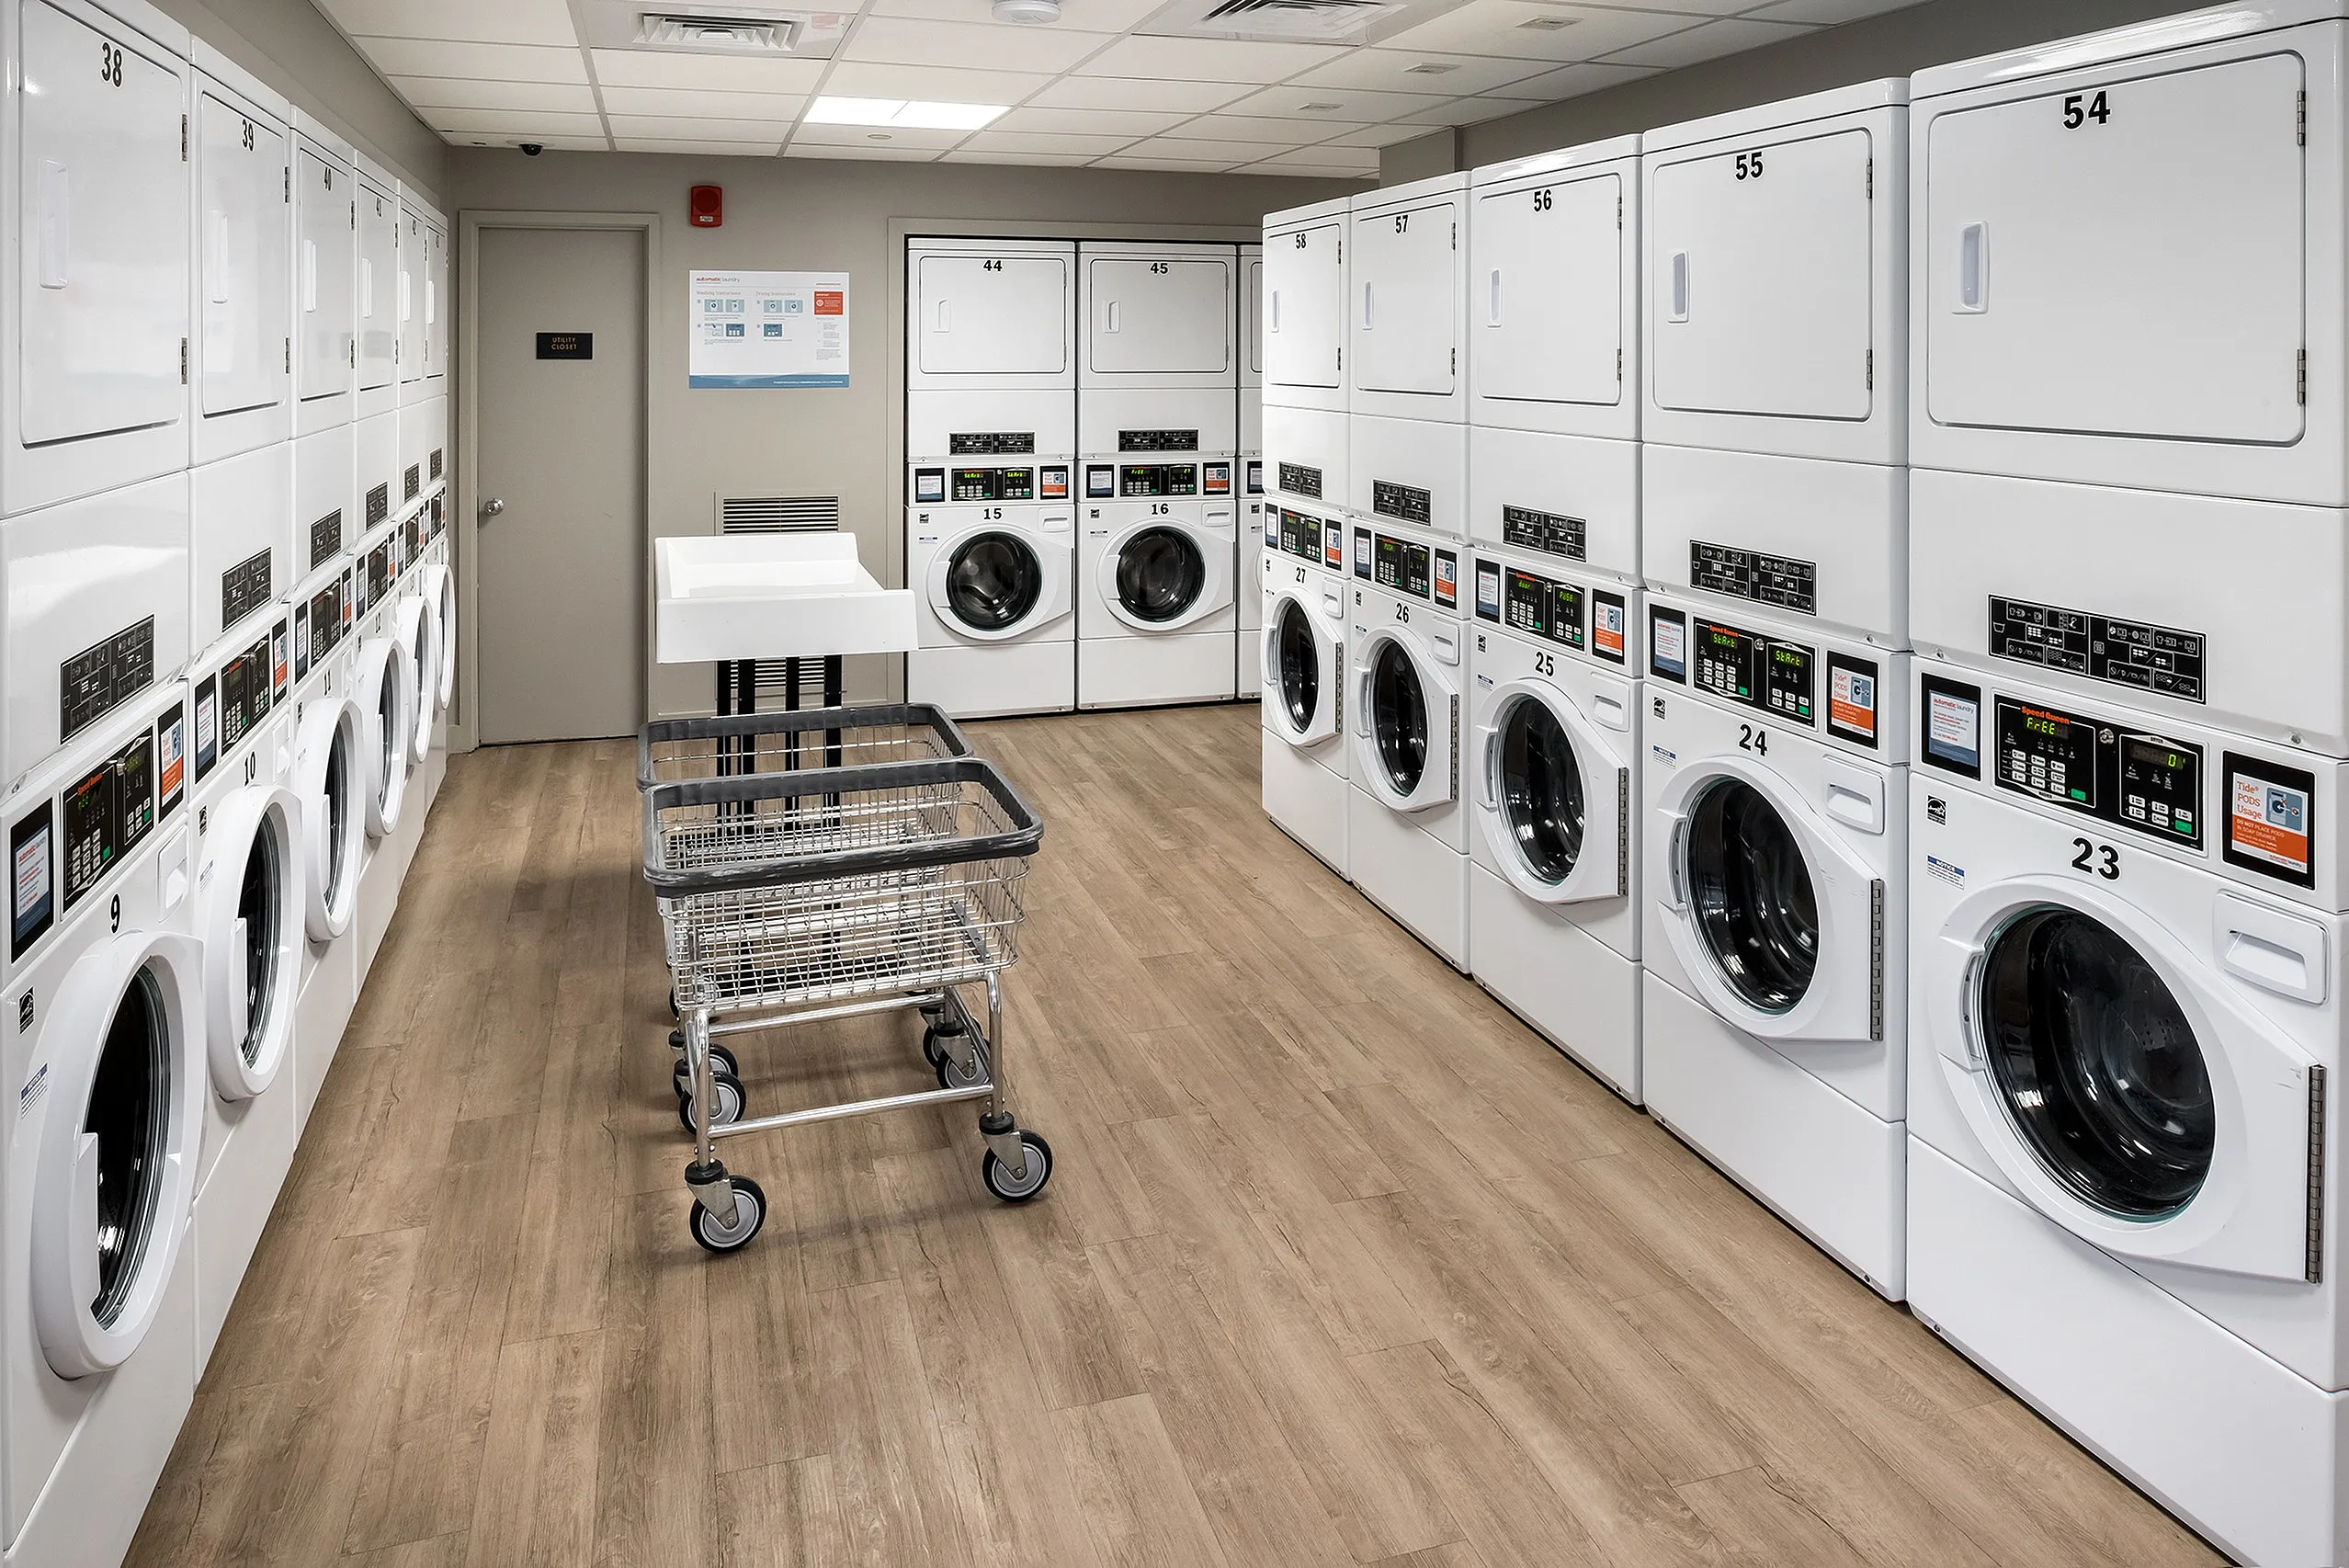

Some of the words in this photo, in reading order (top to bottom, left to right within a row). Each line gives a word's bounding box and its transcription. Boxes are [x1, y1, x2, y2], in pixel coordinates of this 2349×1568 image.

[101, 42, 122, 87] 38
[2063, 90, 2111, 130] 54
[242, 119, 254, 152] 39
[1735, 152, 1763, 180] 55
[1534, 189, 1552, 212] 56
[1395, 215, 1409, 233] 57
[1296, 233, 1307, 249] 58
[983, 260, 1003, 271] 44
[1150, 263, 1168, 274] 45
[983, 508, 1002, 519] 15
[1151, 504, 1169, 515] 16
[1296, 566, 1306, 584] 27
[1396, 602, 1409, 623] 26
[1535, 651, 1554, 676] 25
[323, 668, 332, 696] 11
[1933, 698, 1957, 709] automatic
[1957, 703, 1974, 714] laundry
[2021, 706, 2045, 718] Speed
[2046, 711, 2070, 724] Queen
[1739, 723, 1767, 756] 24
[244, 751, 255, 786] 10
[2237, 793, 2261, 807] PODS
[2237, 804, 2263, 819] Usage
[2242, 826, 2255, 835] SOAP
[2254, 824, 2270, 834] PLACE
[2270, 828, 2285, 838] PODS
[1935, 858, 1957, 872] NOTICE
[2071, 837, 2121, 881] 23
[110, 893, 120, 934] 9
